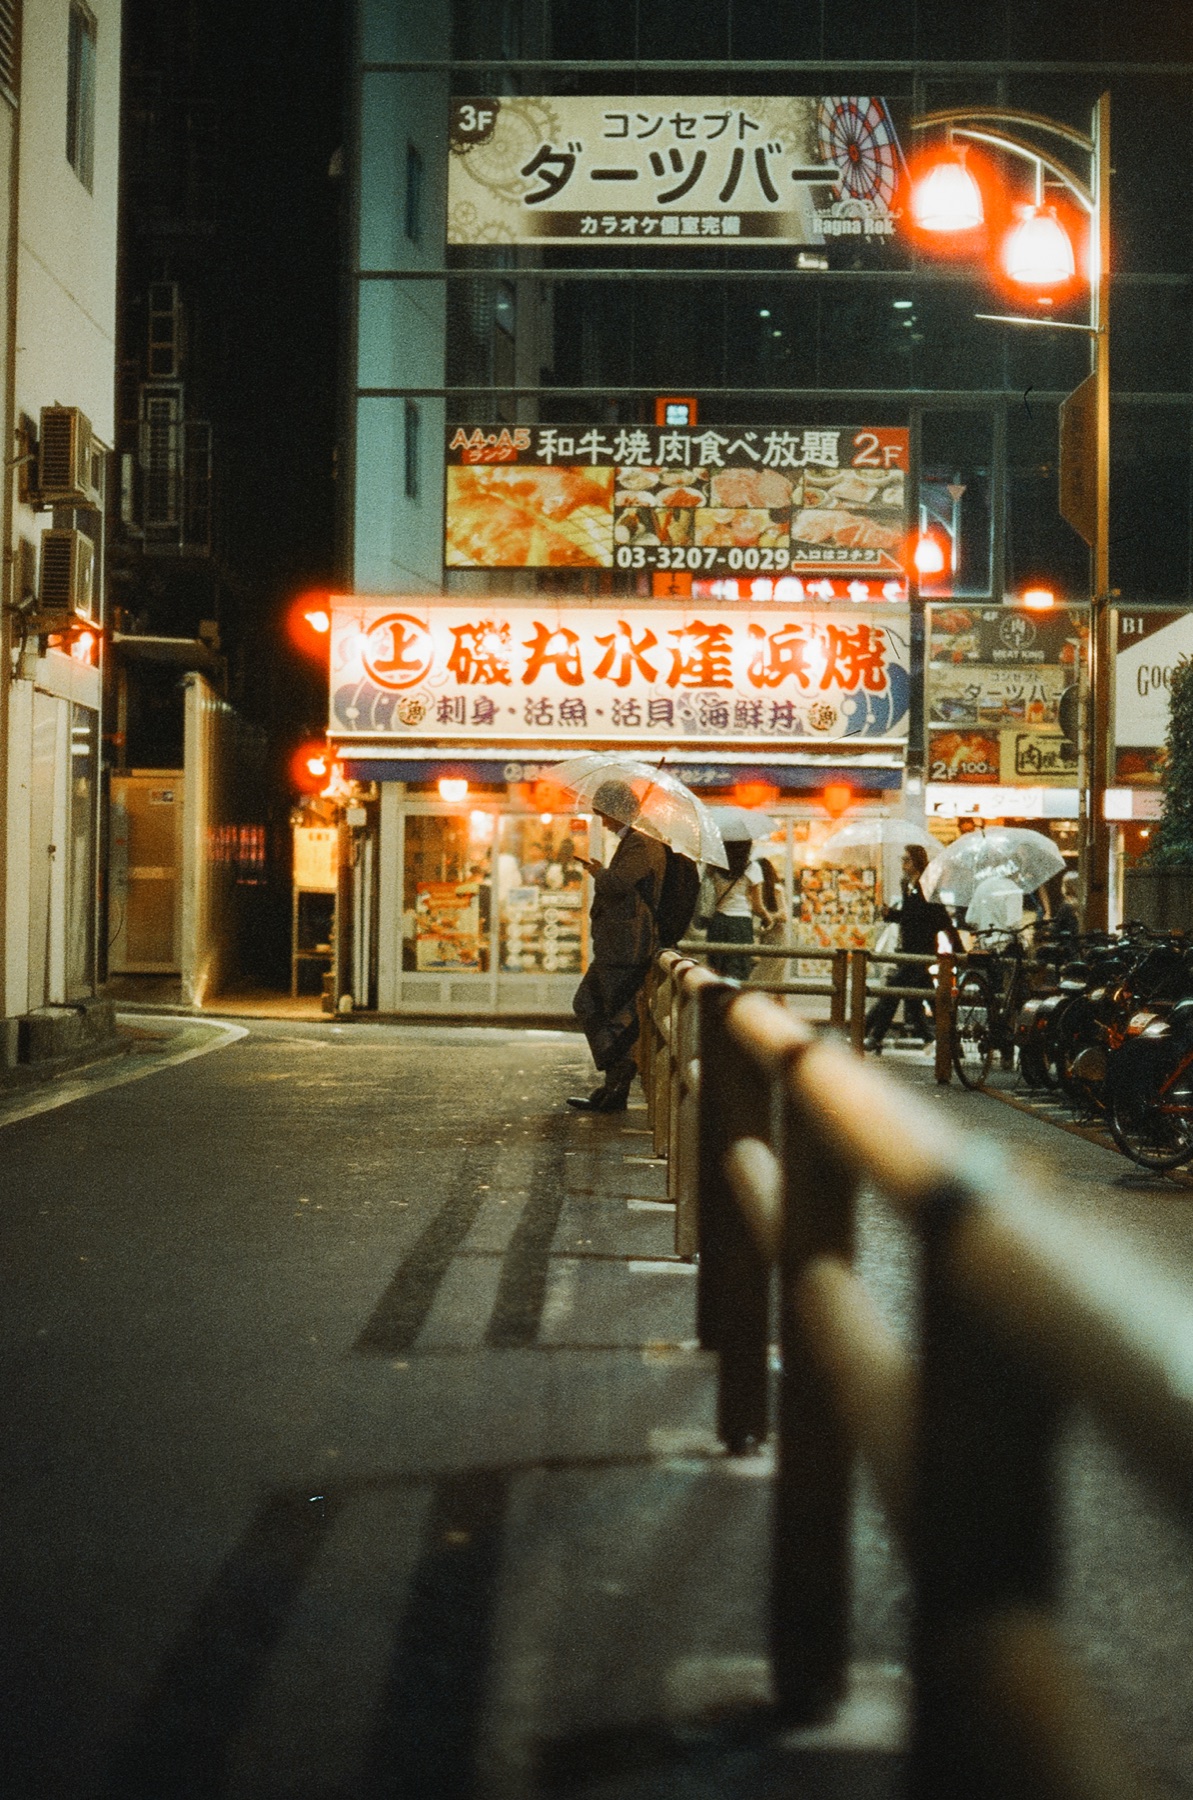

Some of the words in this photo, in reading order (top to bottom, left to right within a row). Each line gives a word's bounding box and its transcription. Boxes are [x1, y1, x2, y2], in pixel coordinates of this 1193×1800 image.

[459, 105, 493, 132] 3F
[604, 111, 760, 139] コンセプト
[521, 142, 840, 204] ダーツバー
[580, 215, 741, 235] カラオケ個室完備
[812, 218, 862, 236] Ragna
[469, 449, 513, 463] ランク
[536, 429, 841, 468] 和牛焼肉食べ放題
[853, 433, 904, 467] 2F
[616, 546, 790, 571] 03-3207-0029
